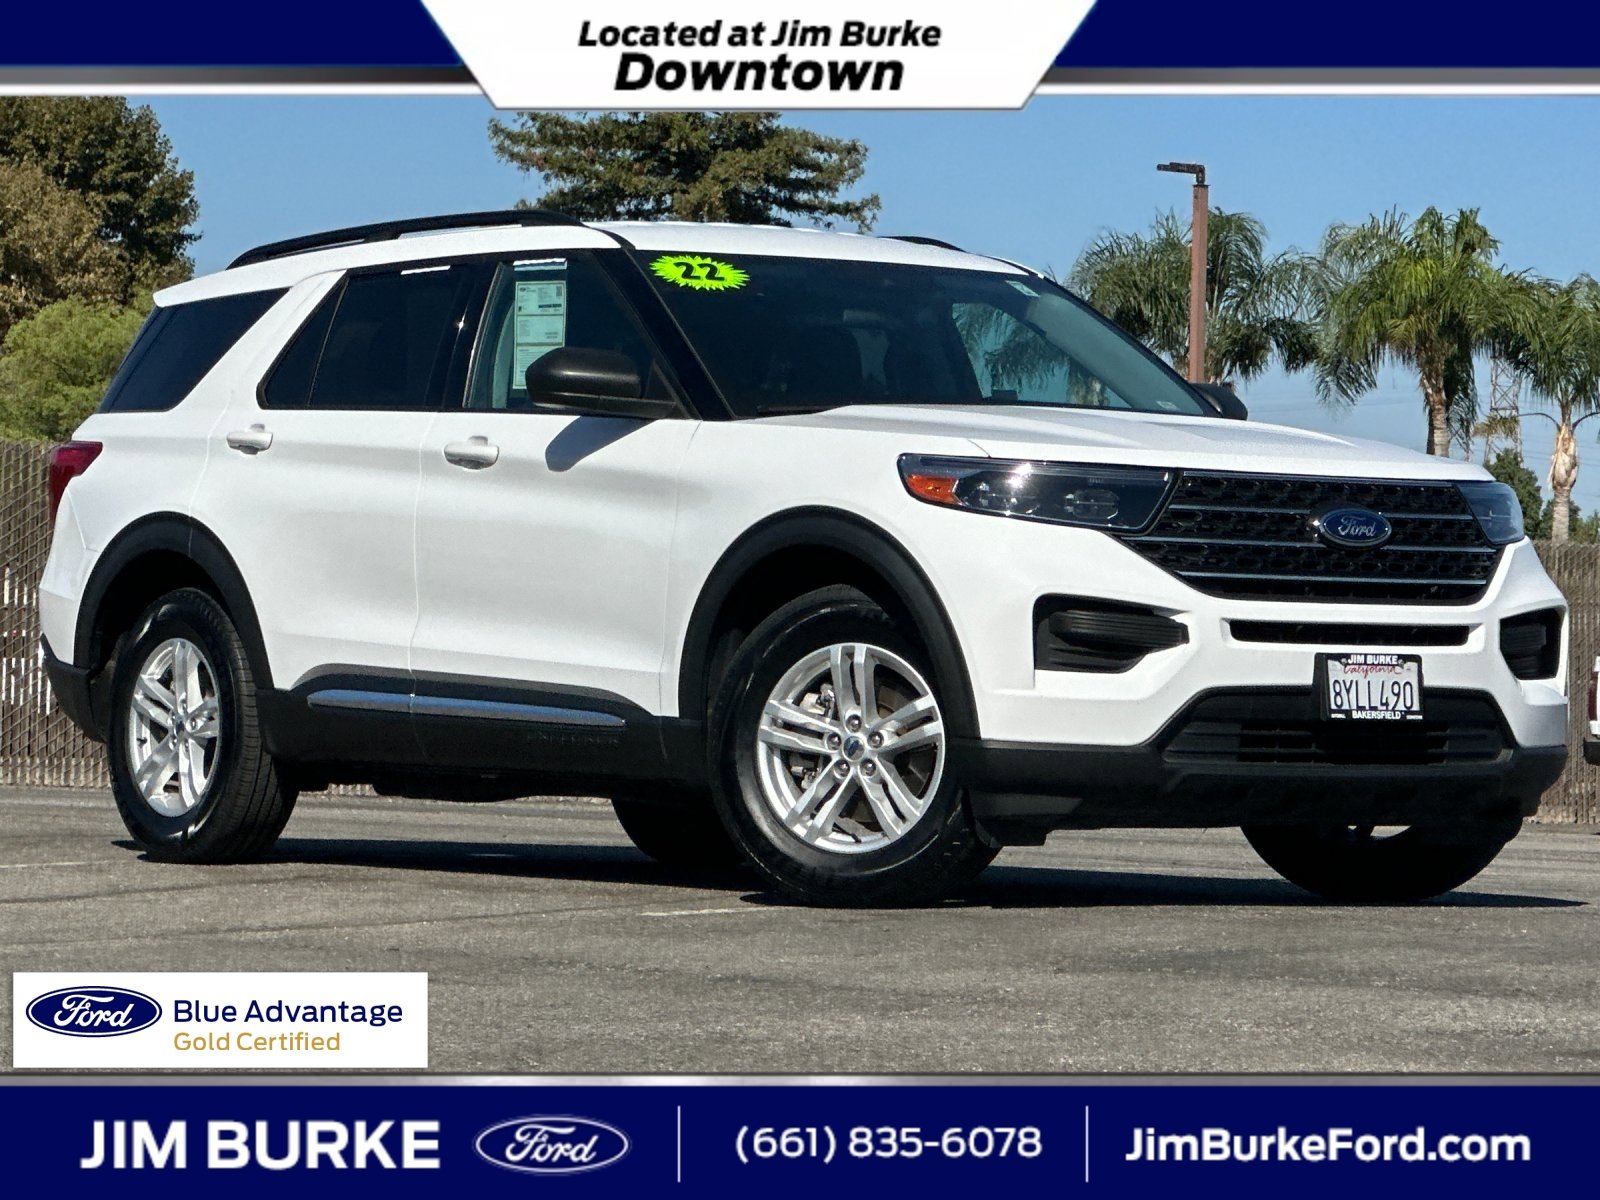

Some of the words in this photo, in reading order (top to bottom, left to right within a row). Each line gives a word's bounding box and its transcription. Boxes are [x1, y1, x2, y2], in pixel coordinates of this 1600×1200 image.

[673, 262, 726, 282] 22
[1338, 515, 1377, 537] Ford
[1348, 655, 1365, 664] JIM
[1366, 655, 1398, 665] BURKE
[1344, 664, 1402, 678] California
[1333, 679, 1413, 710] 8YLL490
[1352, 710, 1401, 720] BAKERSFIELD
